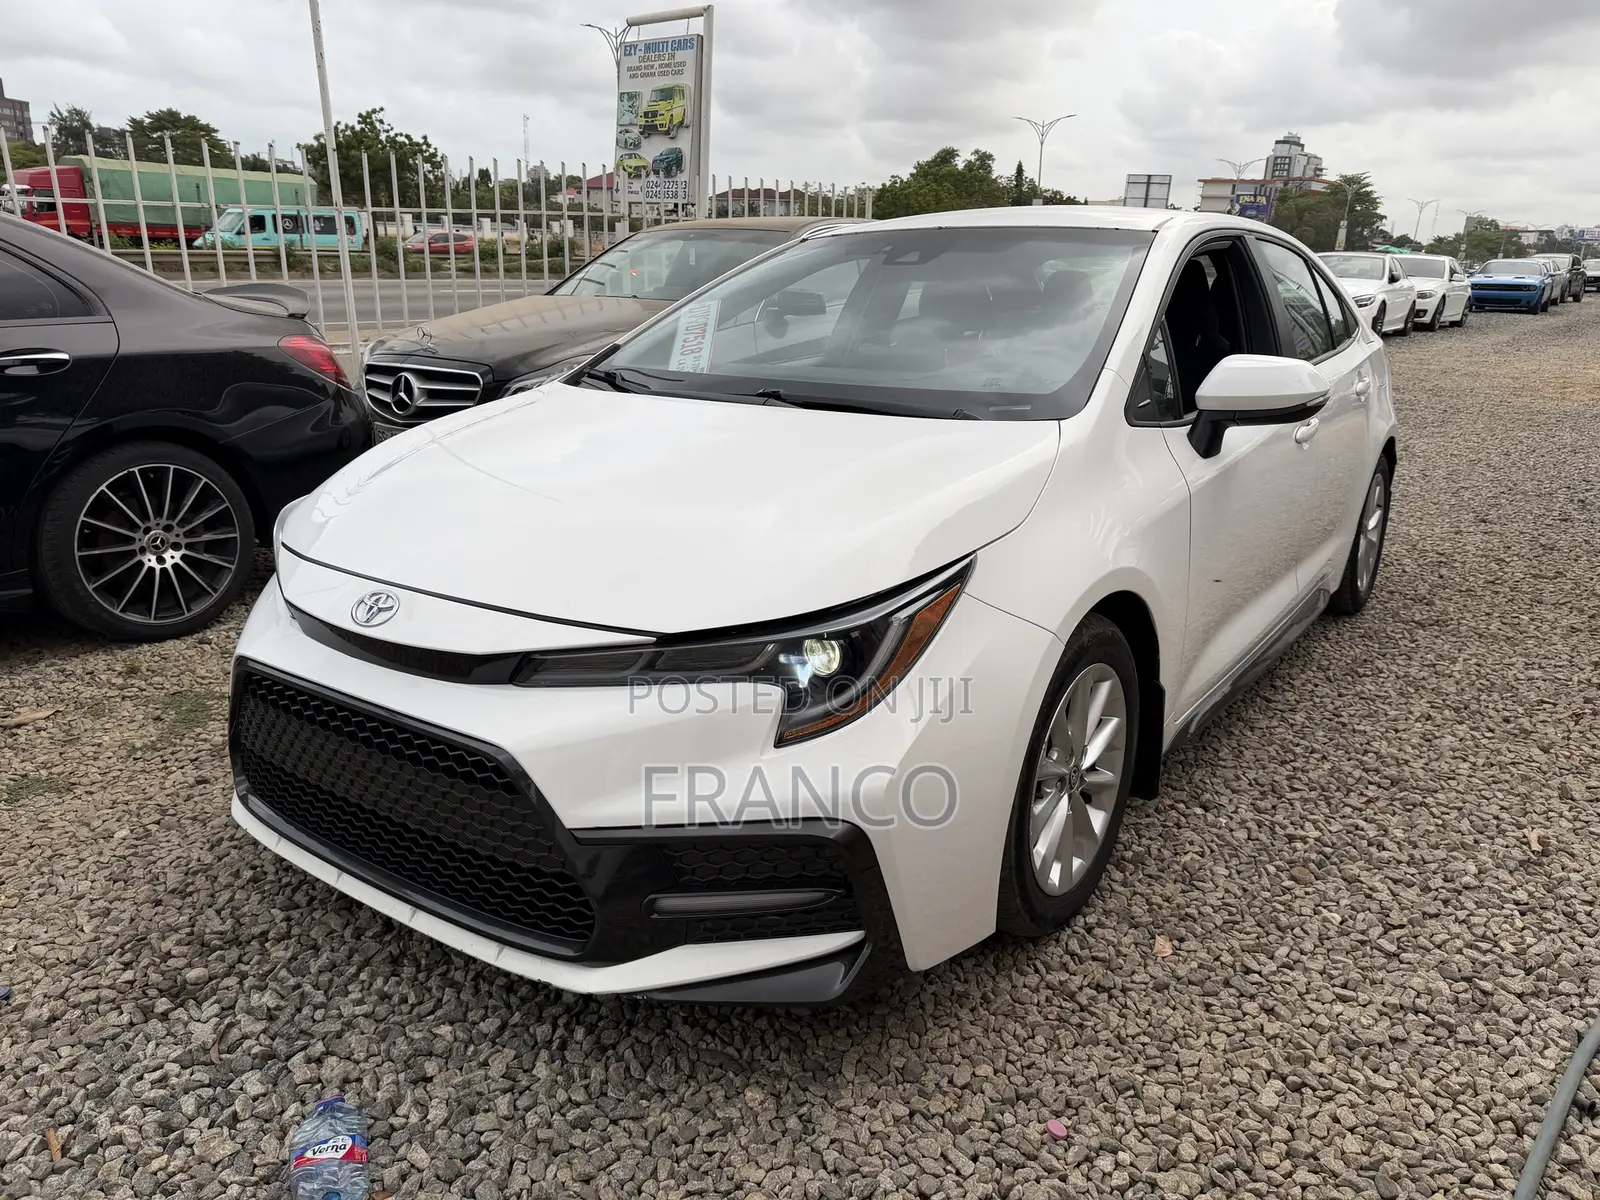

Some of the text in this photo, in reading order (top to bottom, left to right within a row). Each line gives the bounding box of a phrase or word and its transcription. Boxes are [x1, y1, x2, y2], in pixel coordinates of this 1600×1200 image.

[624, 44, 638, 57] EZY
[643, 40, 669, 54] MULTI
[671, 38, 695, 51] CARS
[638, 52, 675, 63] DEALERS IN
[658, 62, 673, 70] HOME
[311, 1143, 347, 1156] Verna
